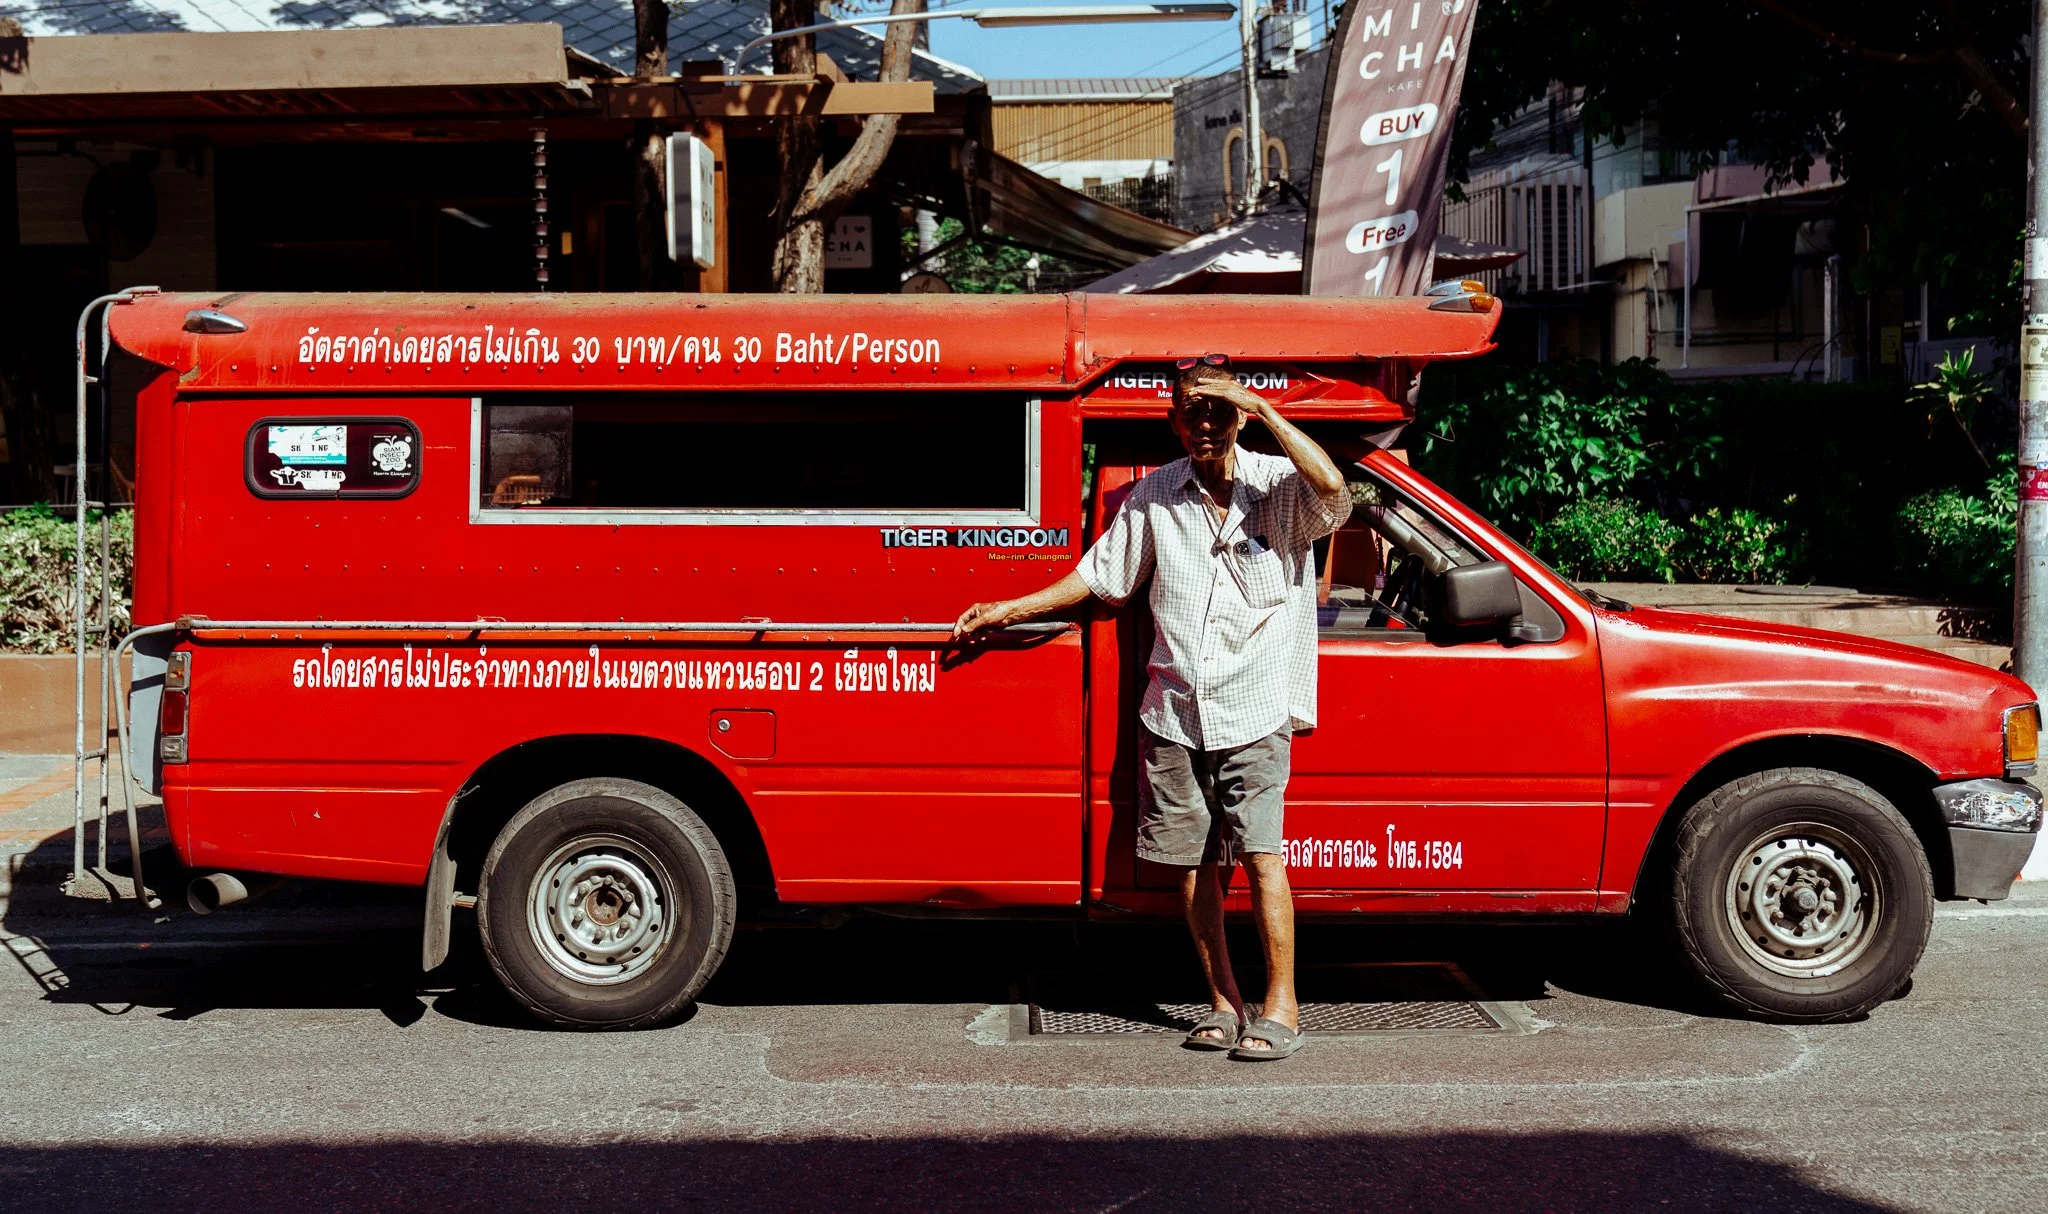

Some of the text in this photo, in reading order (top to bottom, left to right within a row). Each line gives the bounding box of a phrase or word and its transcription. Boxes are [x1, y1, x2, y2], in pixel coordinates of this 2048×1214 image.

[1362, 2, 1421, 43] MI
[1359, 35, 1456, 80] CHA
[1387, 79, 1423, 94] KAFE
[1379, 111, 1425, 137] BUY
[1376, 148, 1403, 206] 1
[826, 241, 866, 252] CHA
[1362, 223, 1407, 247] Free
[571, 336, 600, 364] 30
[614, 335, 722, 365] บาท/คน
[733, 336, 762, 364] 30
[775, 332, 941, 365] Baht/Person
[880, 529, 1068, 547] TIGER KINGDOM
[1028, 552, 1072, 561] Chiangmai
[809, 661, 824, 691] 2
[835, 646, 936, 692] เชียงใหม่
[1386, 824, 1463, 869] โทร.1584
